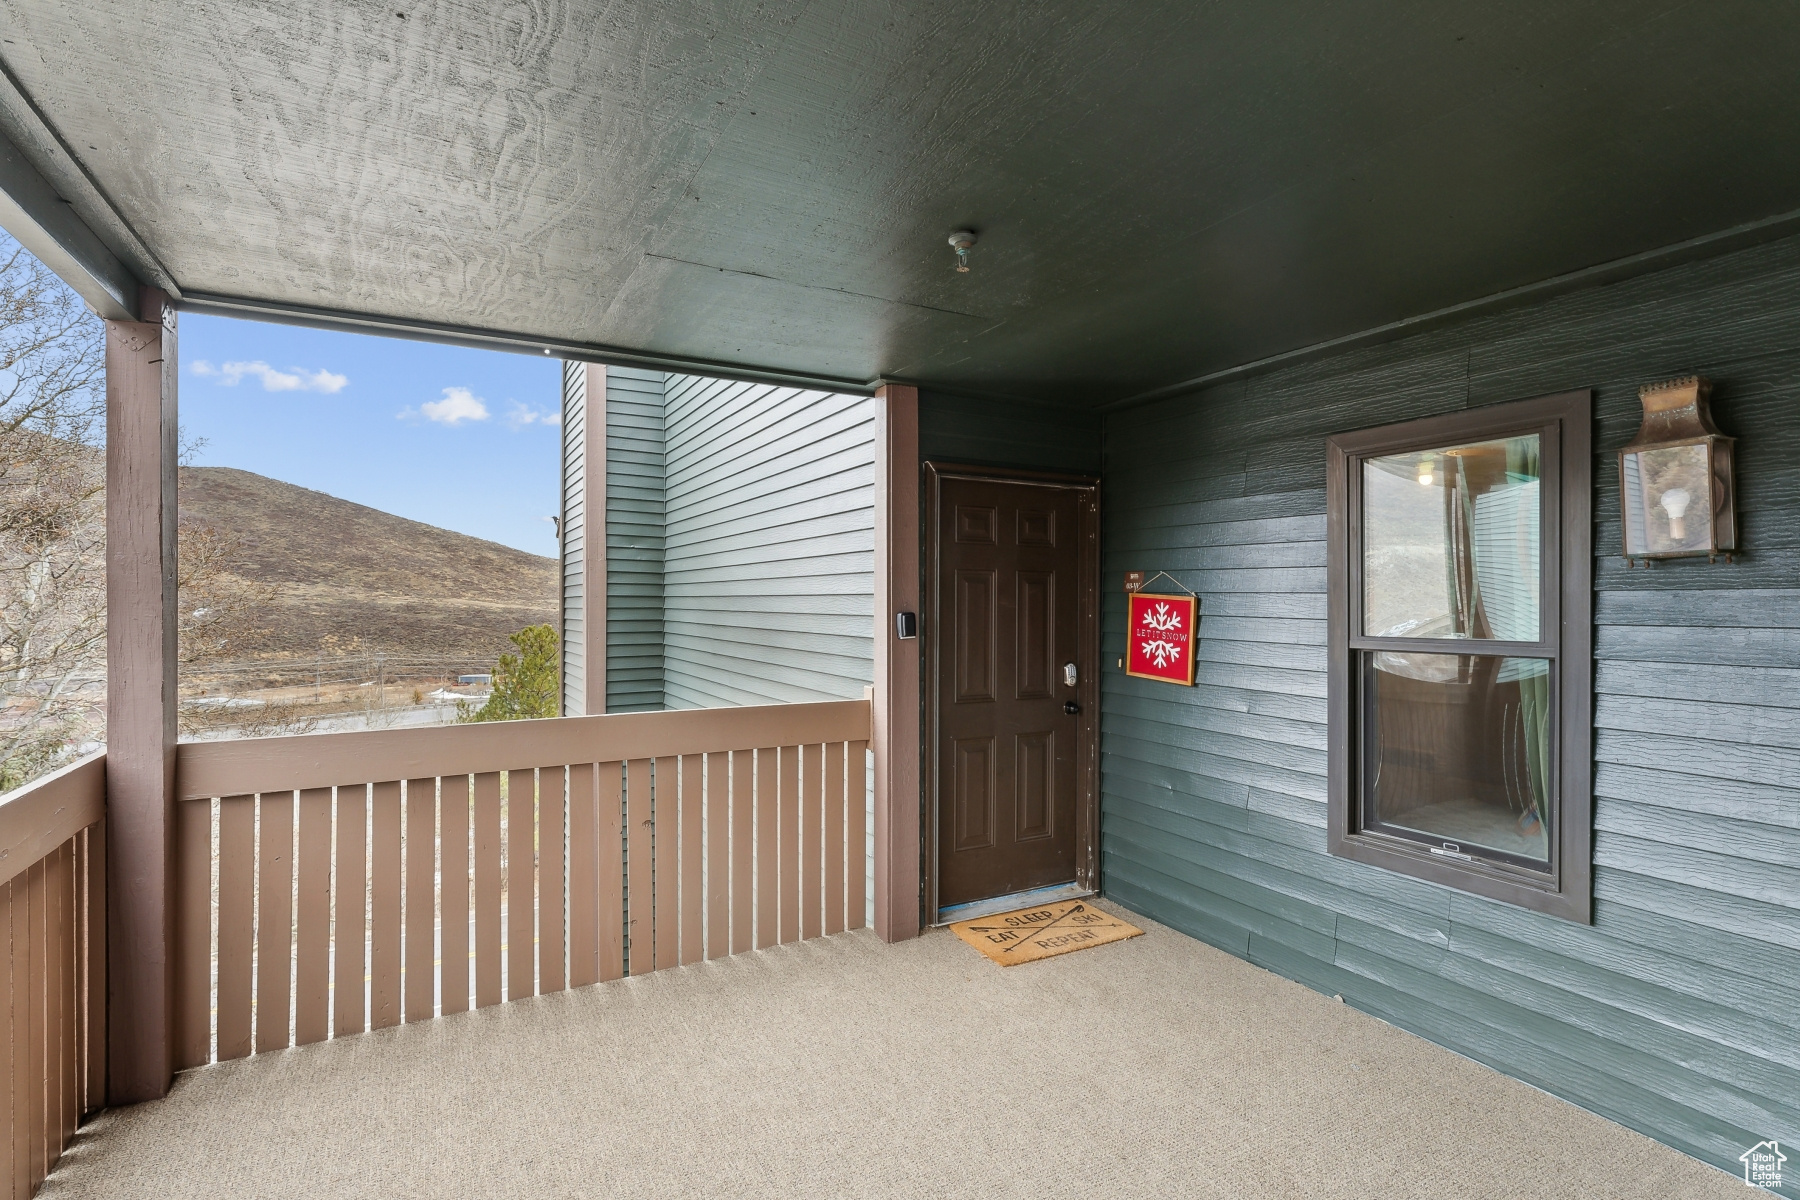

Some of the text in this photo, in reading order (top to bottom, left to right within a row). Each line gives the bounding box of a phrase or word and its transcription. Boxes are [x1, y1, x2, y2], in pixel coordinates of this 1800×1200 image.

[1136, 628, 1151, 638] LET
[1161, 631, 1187, 642] SNOW
[1004, 910, 1053, 927] SLEEP
[1071, 913, 1104, 925] SKI
[986, 930, 1020, 944] EAT
[1034, 929, 1099, 950] REPEAT
